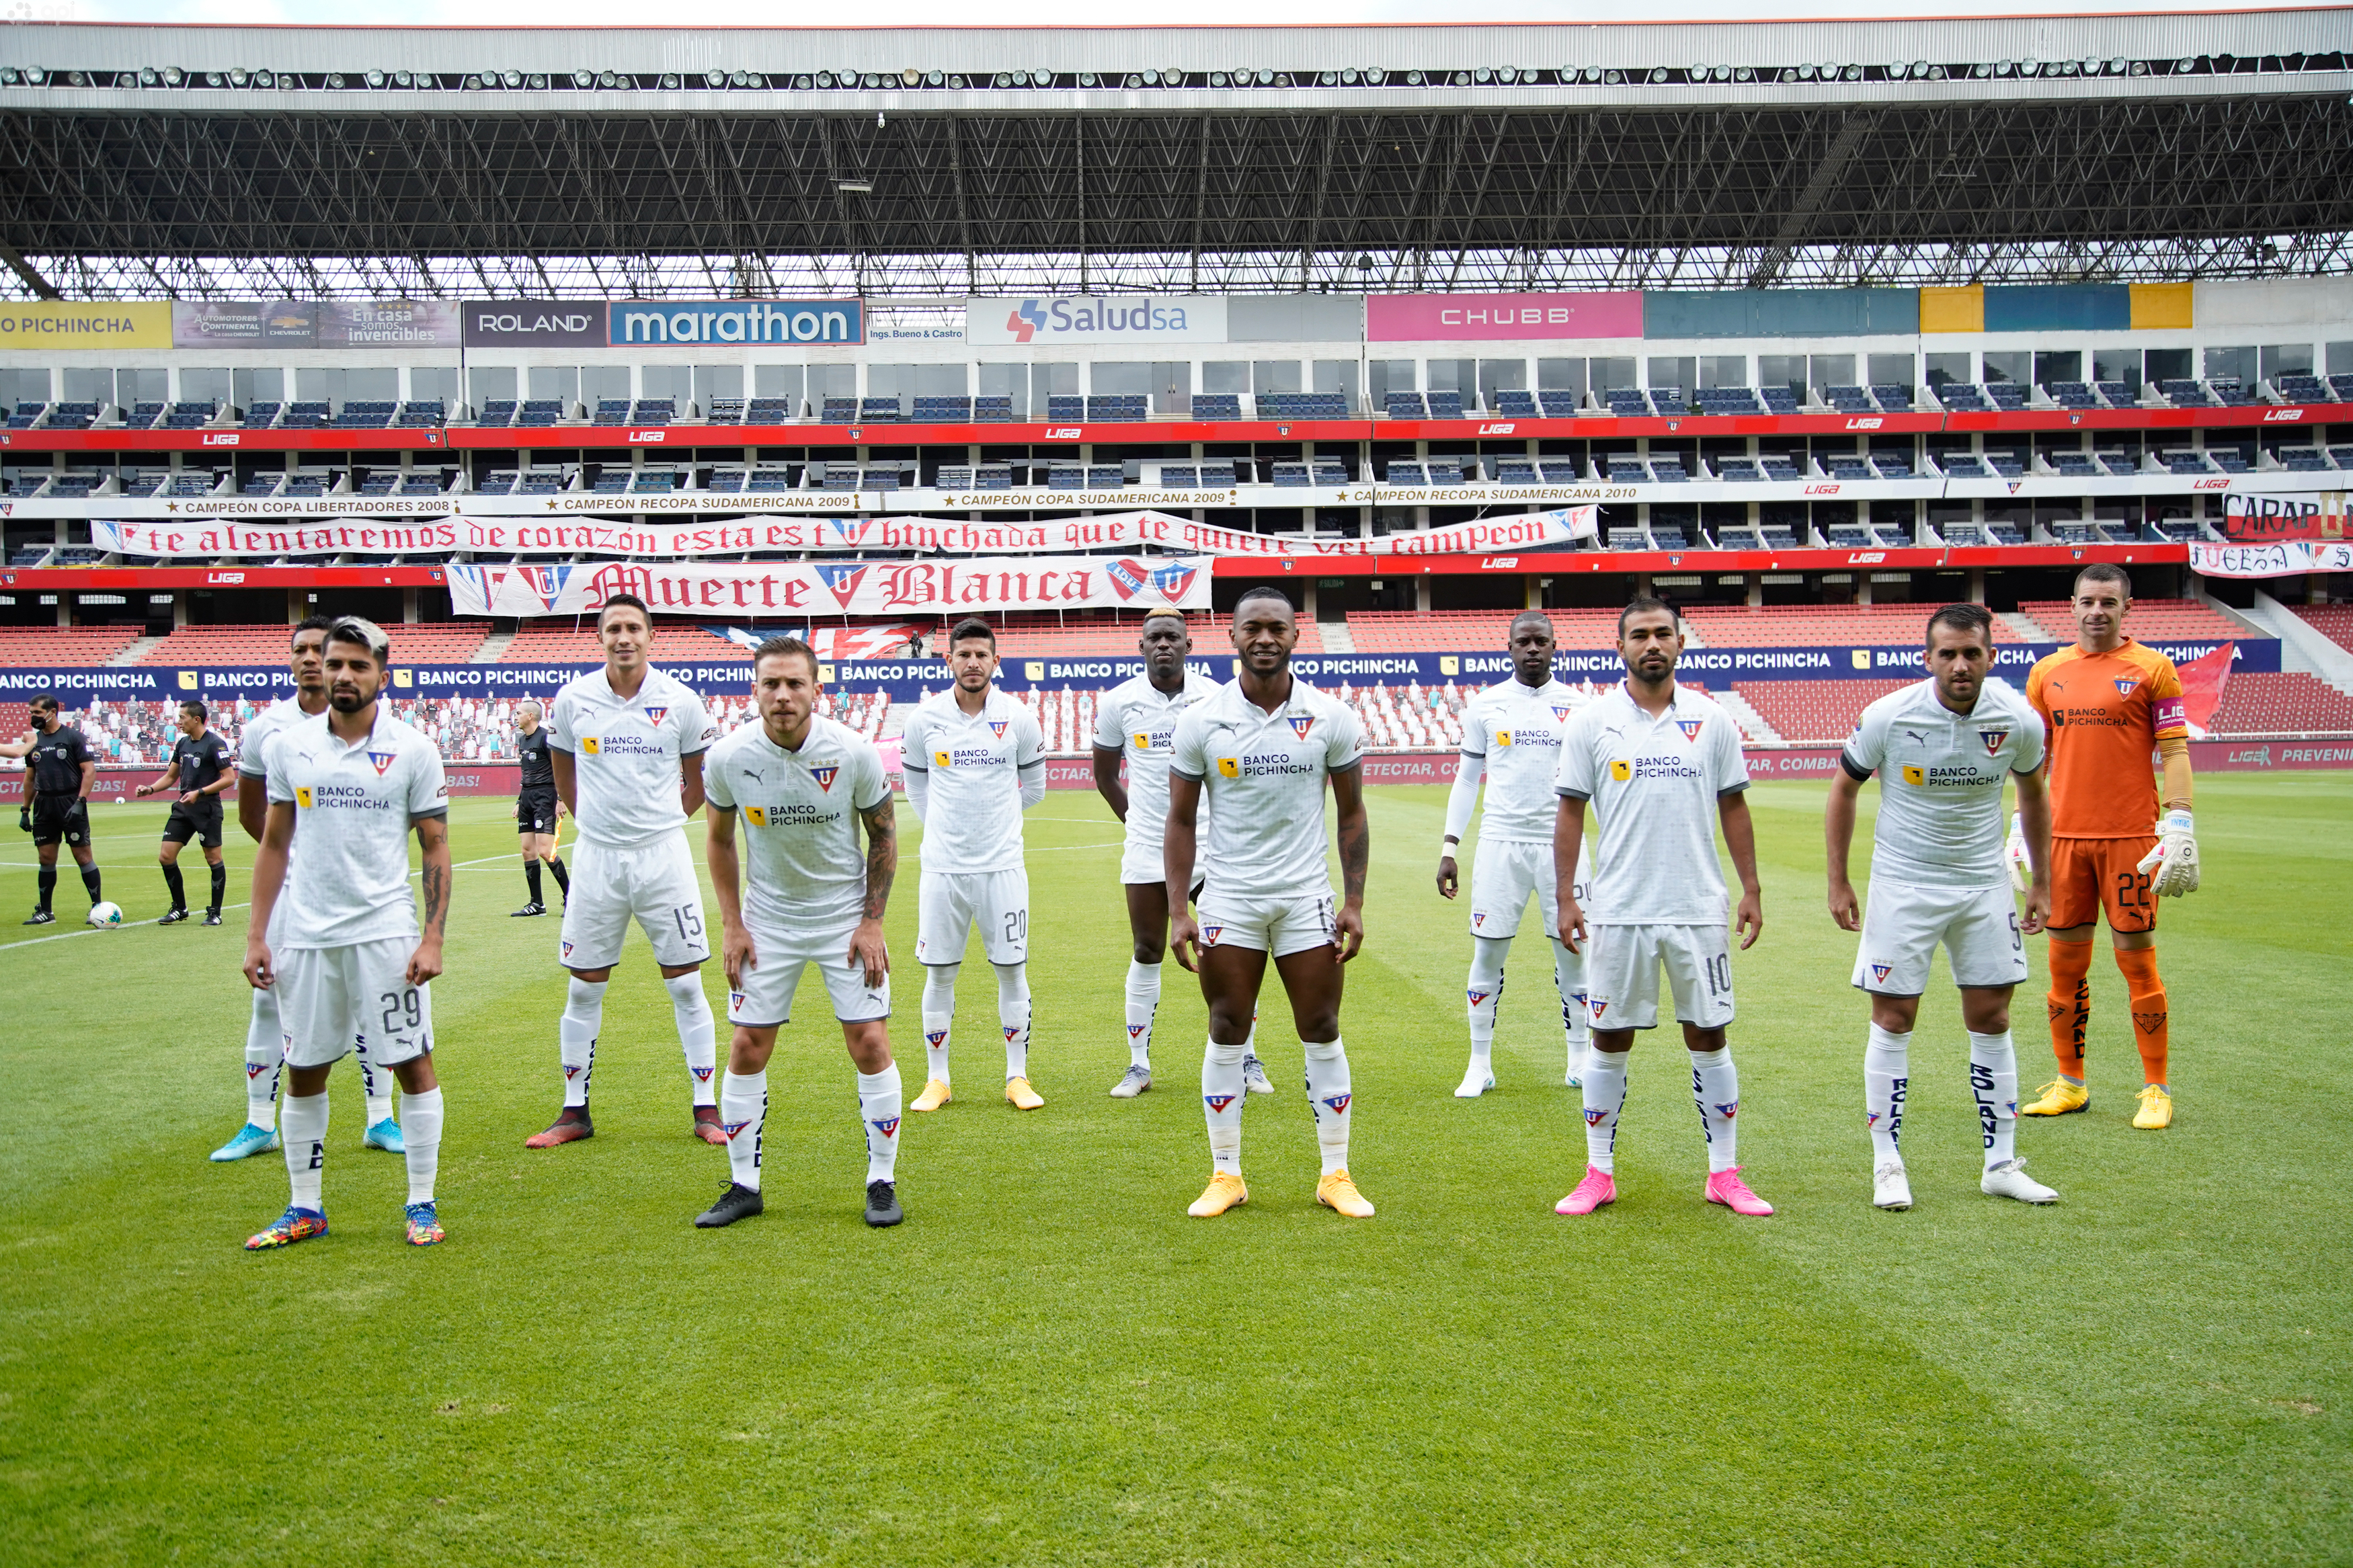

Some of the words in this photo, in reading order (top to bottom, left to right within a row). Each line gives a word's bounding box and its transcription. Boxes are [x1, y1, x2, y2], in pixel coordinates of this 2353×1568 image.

[194, 313, 258, 324] AUTOMOTORES
[352, 308, 374, 322] En
[1051, 299, 1187, 331] Saludsa
[22, 319, 134, 332] PICHINCHA
[201, 321, 260, 332] CONTINENTAL
[361, 321, 399, 331] somos
[626, 304, 847, 341] marathon
[348, 327, 436, 341] invencibles
[870, 330, 891, 340] Ings.
[961, 492, 1031, 505] CAMPEÓN
[1037, 495, 1073, 504] COPA
[1078, 494, 1189, 504] SUDAMERICANA
[1194, 493, 1224, 502] 2009
[1355, 487, 1426, 504] CAMPEÓN
[1431, 491, 1485, 499] RECOPA
[1490, 489, 1600, 499] SUDAMERICANA
[1605, 489, 1636, 497] 2010
[186, 500, 257, 513] CAMPEÓN
[263, 503, 302, 512] COPA
[307, 502, 413, 511] LIBERTADORES
[418, 501, 448, 511] 2008
[565, 496, 635, 510] CAMPEÓN
[641, 499, 697, 508] RECOPA
[703, 497, 813, 507] SUDAMERICANA
[819, 497, 849, 506] 2009
[149, 530, 184, 552] te
[200, 525, 455, 551] alentaremos
[465, 520, 505, 547] de
[518, 526, 656, 552] corazón
[674, 528, 754, 551] esta
[766, 526, 803, 546] es
[882, 522, 1046, 550] hinchada
[1066, 523, 1124, 548] que
[1138, 517, 1169, 540] te
[1392, 519, 1546, 555] campeón
[584, 562, 810, 610] Muerte
[878, 565, 1091, 611] Blanca
[1465, 657, 1516, 672] BANC
[1548, 656, 1625, 671] CHINCHA
[1673, 655, 1732, 669] BANCO
[1736, 653, 1831, 668] PICHINCHA
[1877, 651, 1923, 666] BANC
[842, 666, 903, 679] BANCO
[1051, 663, 1111, 677] BANCO
[1323, 659, 1419, 673] PICHINCHA
[55, 674, 156, 688] PICHINCHA
[204, 673, 268, 686] BANCO
[420, 671, 481, 684] BANCO
[485, 670, 581, 684] PICHINCHA
[696, 667, 757, 682] PICHIN
[2068, 708, 2106, 717] BANCO
[2159, 706, 2185, 720] LIG
[2068, 717, 2128, 727] PICHINCHA
[1152, 732, 1172, 740] BAN
[1515, 738, 1562, 747] PICHINCH
[955, 749, 988, 757] BANCO
[1244, 754, 1289, 765] BANCO
[955, 757, 1006, 766] PICHINCHA
[1636, 757, 1680, 767] BANCO
[1780, 757, 1839, 771] COMBA
[1244, 764, 1312, 776] PICHINCHA
[1363, 764, 1435, 777] ETECTAR,
[1636, 768, 1702, 778] PICHINCHA
[1930, 768, 1977, 776] BANCO
[1929, 772, 1999, 786] PICHINCHA
[318, 787, 364, 796] BANCO
[318, 798, 389, 809] PICHINCHA
[770, 805, 815, 815] BANCO
[770, 809, 840, 826] PICHINCHA
[2118, 873, 2151, 906] 22
[674, 903, 702, 940] 15
[1004, 909, 1026, 942] 20
[2008, 912, 2022, 951] 5
[1706, 953, 1731, 997] 10
[381, 989, 421, 1034] 29
[2073, 978, 2089, 1059] ROLAND
[1969, 1062, 1995, 1149] ROLAND
